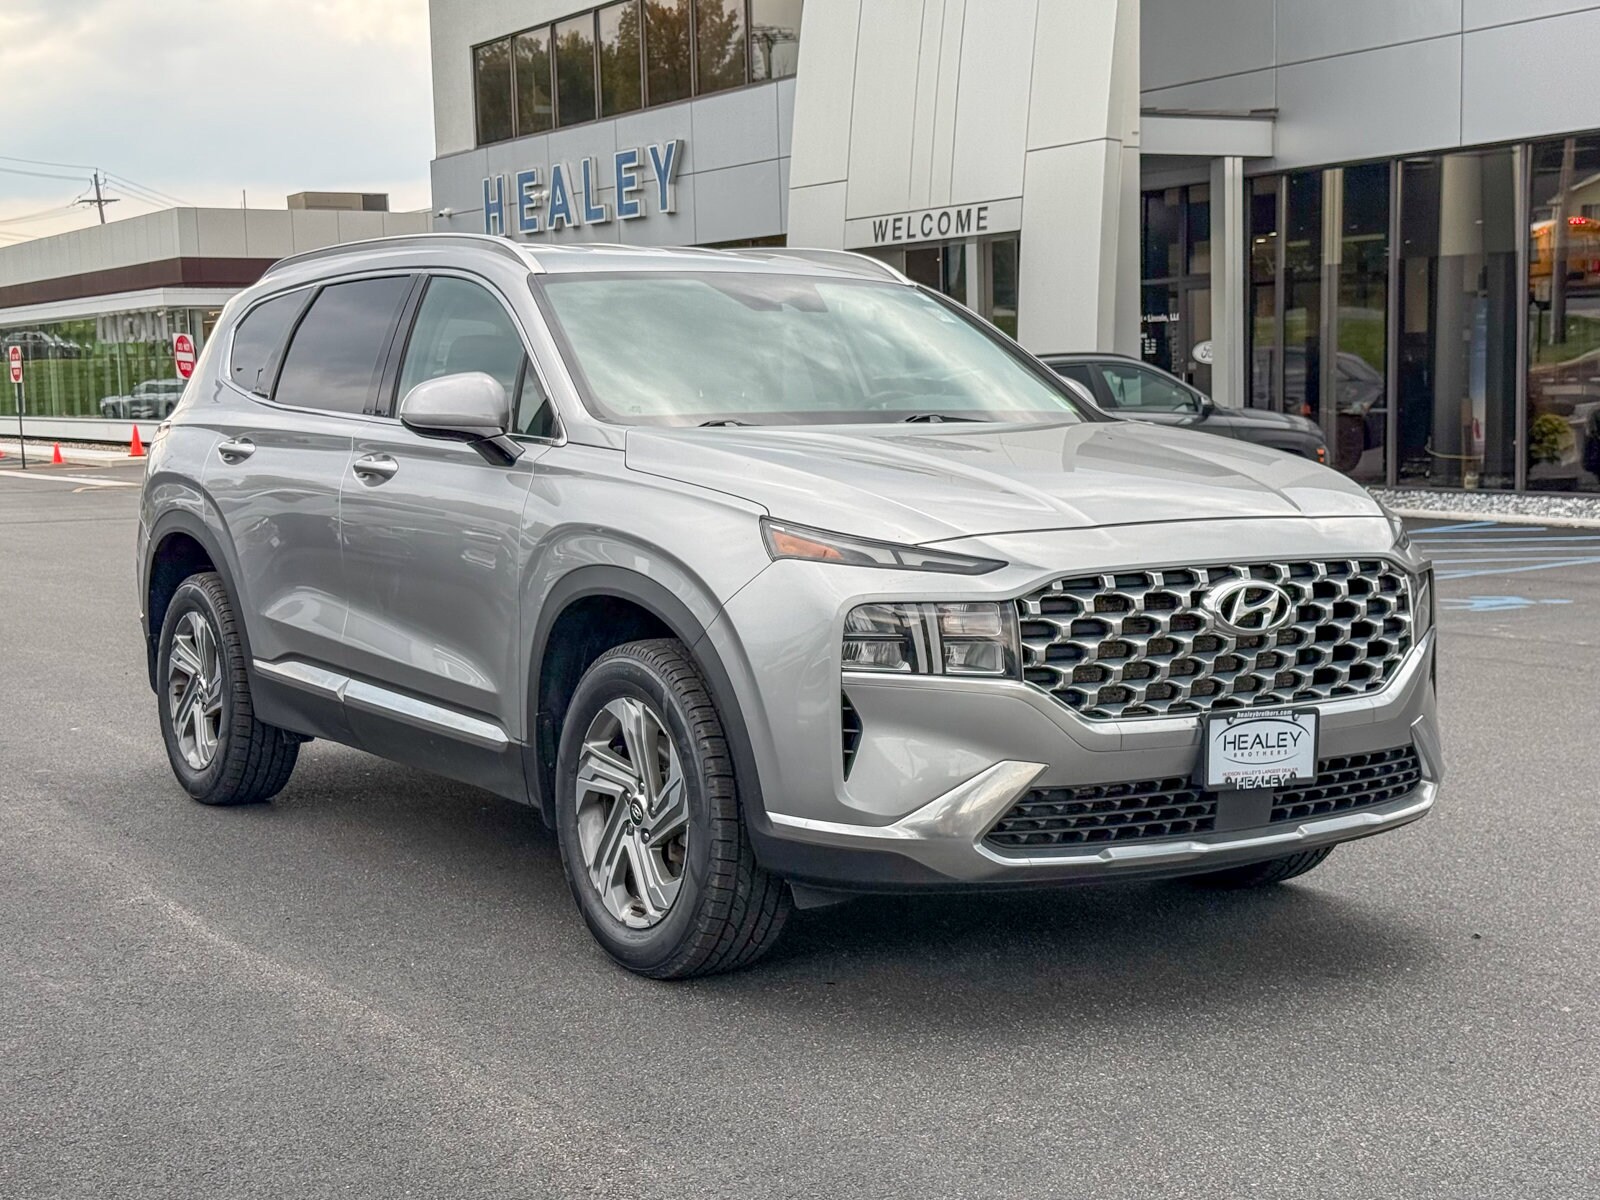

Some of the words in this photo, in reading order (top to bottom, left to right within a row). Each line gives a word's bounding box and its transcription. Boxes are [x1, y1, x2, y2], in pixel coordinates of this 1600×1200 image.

[482, 139, 683, 236] HEALEY
[873, 206, 988, 243] WELCOME
[1236, 710, 1293, 719] healeybrothers.com
[1223, 731, 1303, 752] HEALEY
[1233, 749, 1288, 758] BROTHERS
[1235, 774, 1287, 791] HEALEY
